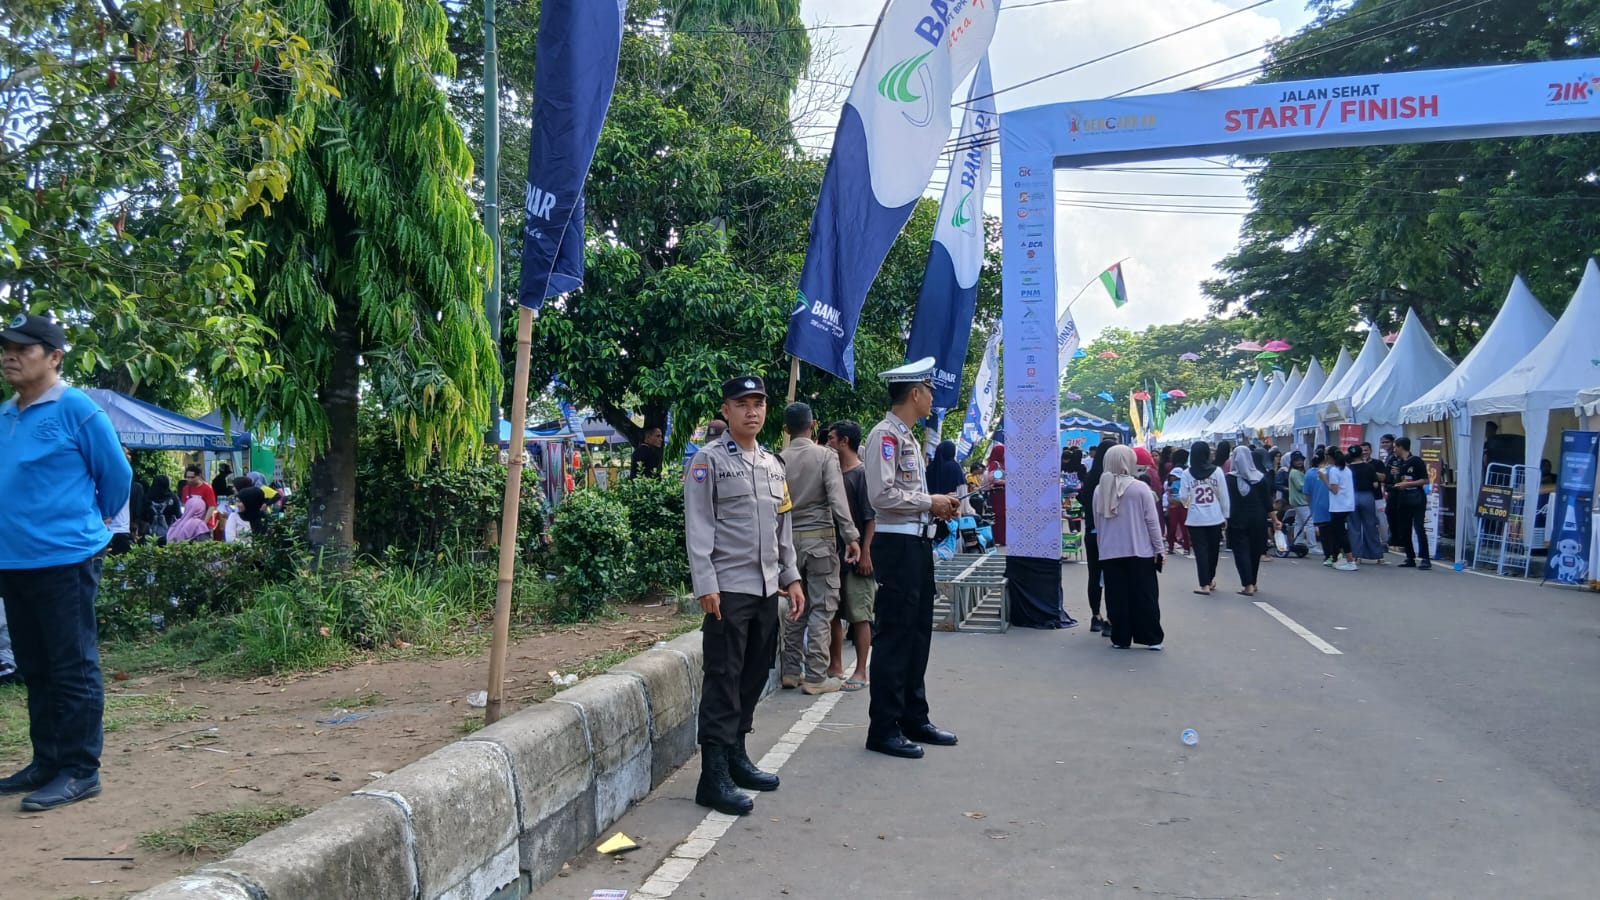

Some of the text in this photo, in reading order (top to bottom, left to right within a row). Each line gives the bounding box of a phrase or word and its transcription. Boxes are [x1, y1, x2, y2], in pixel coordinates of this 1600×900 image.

[1279, 83, 1380, 104] JALAN SEHAT
[1223, 94, 1439, 132] START/ FINISH
[1195, 487, 1214, 504] 23
